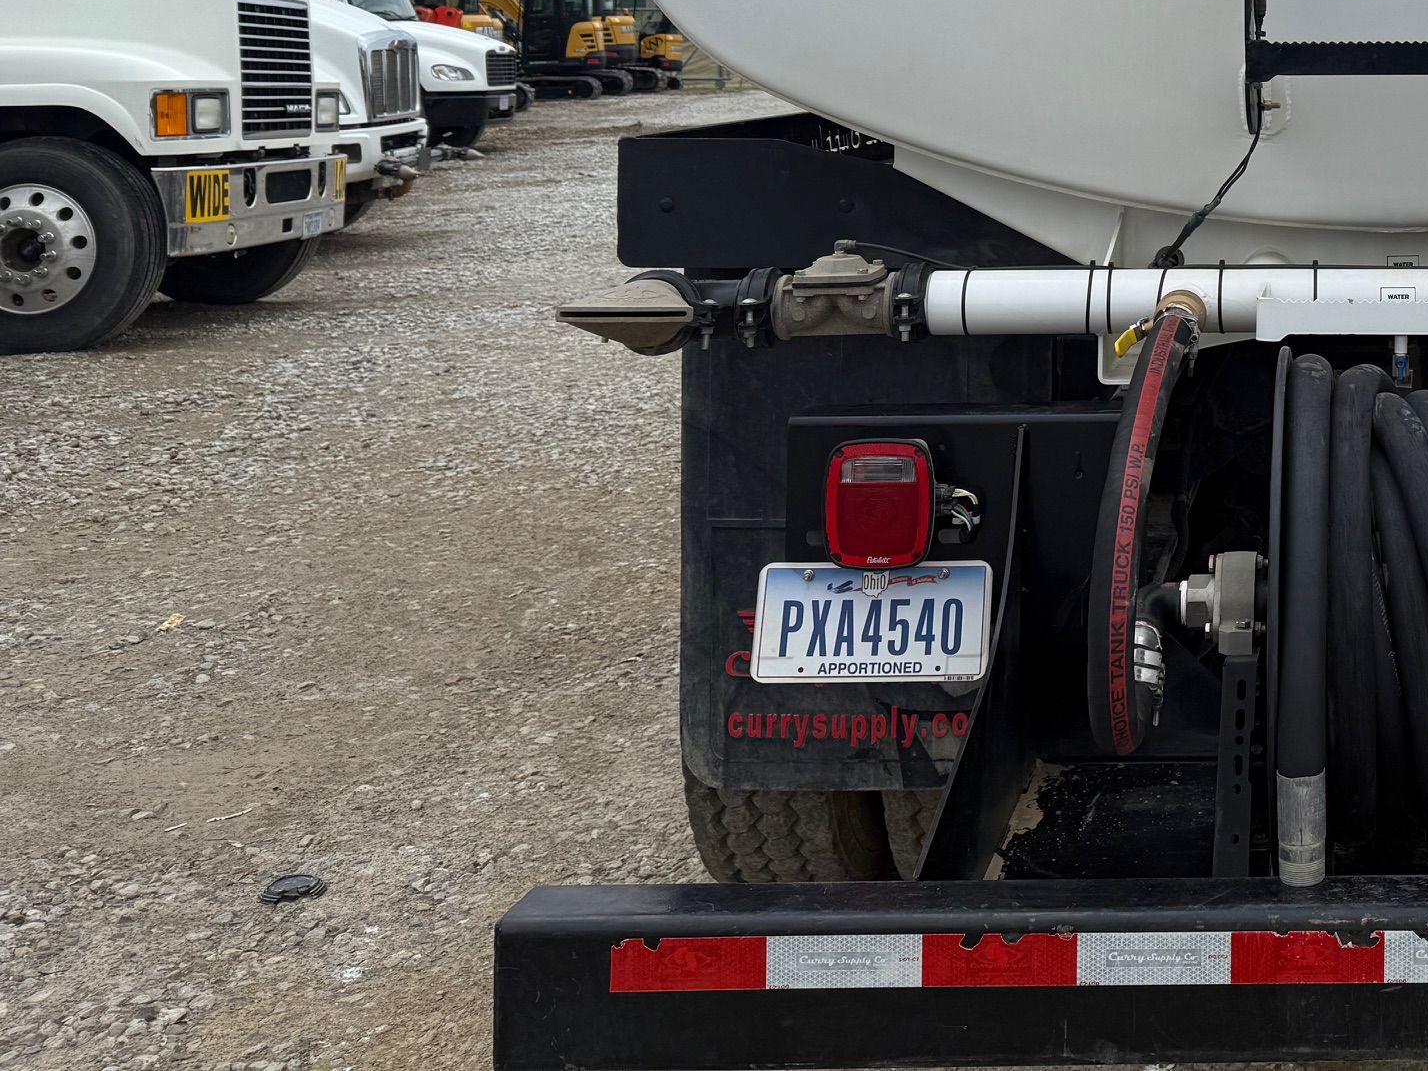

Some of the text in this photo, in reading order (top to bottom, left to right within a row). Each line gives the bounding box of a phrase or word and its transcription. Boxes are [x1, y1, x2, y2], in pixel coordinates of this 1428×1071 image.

[188, 172, 230, 219] WIDE
[1123, 472, 1140, 500] PSI
[1119, 504, 1138, 536] 150
[1112, 535, 1132, 610] TRUCK
[778, 598, 964, 658] PXA4540
[817, 661, 923, 675] APPORTIONED
[1110, 624, 1126, 681] TANK
[727, 705, 969, 748] currysupply.co
[798, 954, 838, 967] Curry
[837, 955, 871, 966] Supply
[873, 955, 889, 965] Co
[1107, 951, 1148, 964] Curry
[1147, 952, 1181, 963] Supply
[1183, 952, 1199, 962] Co
